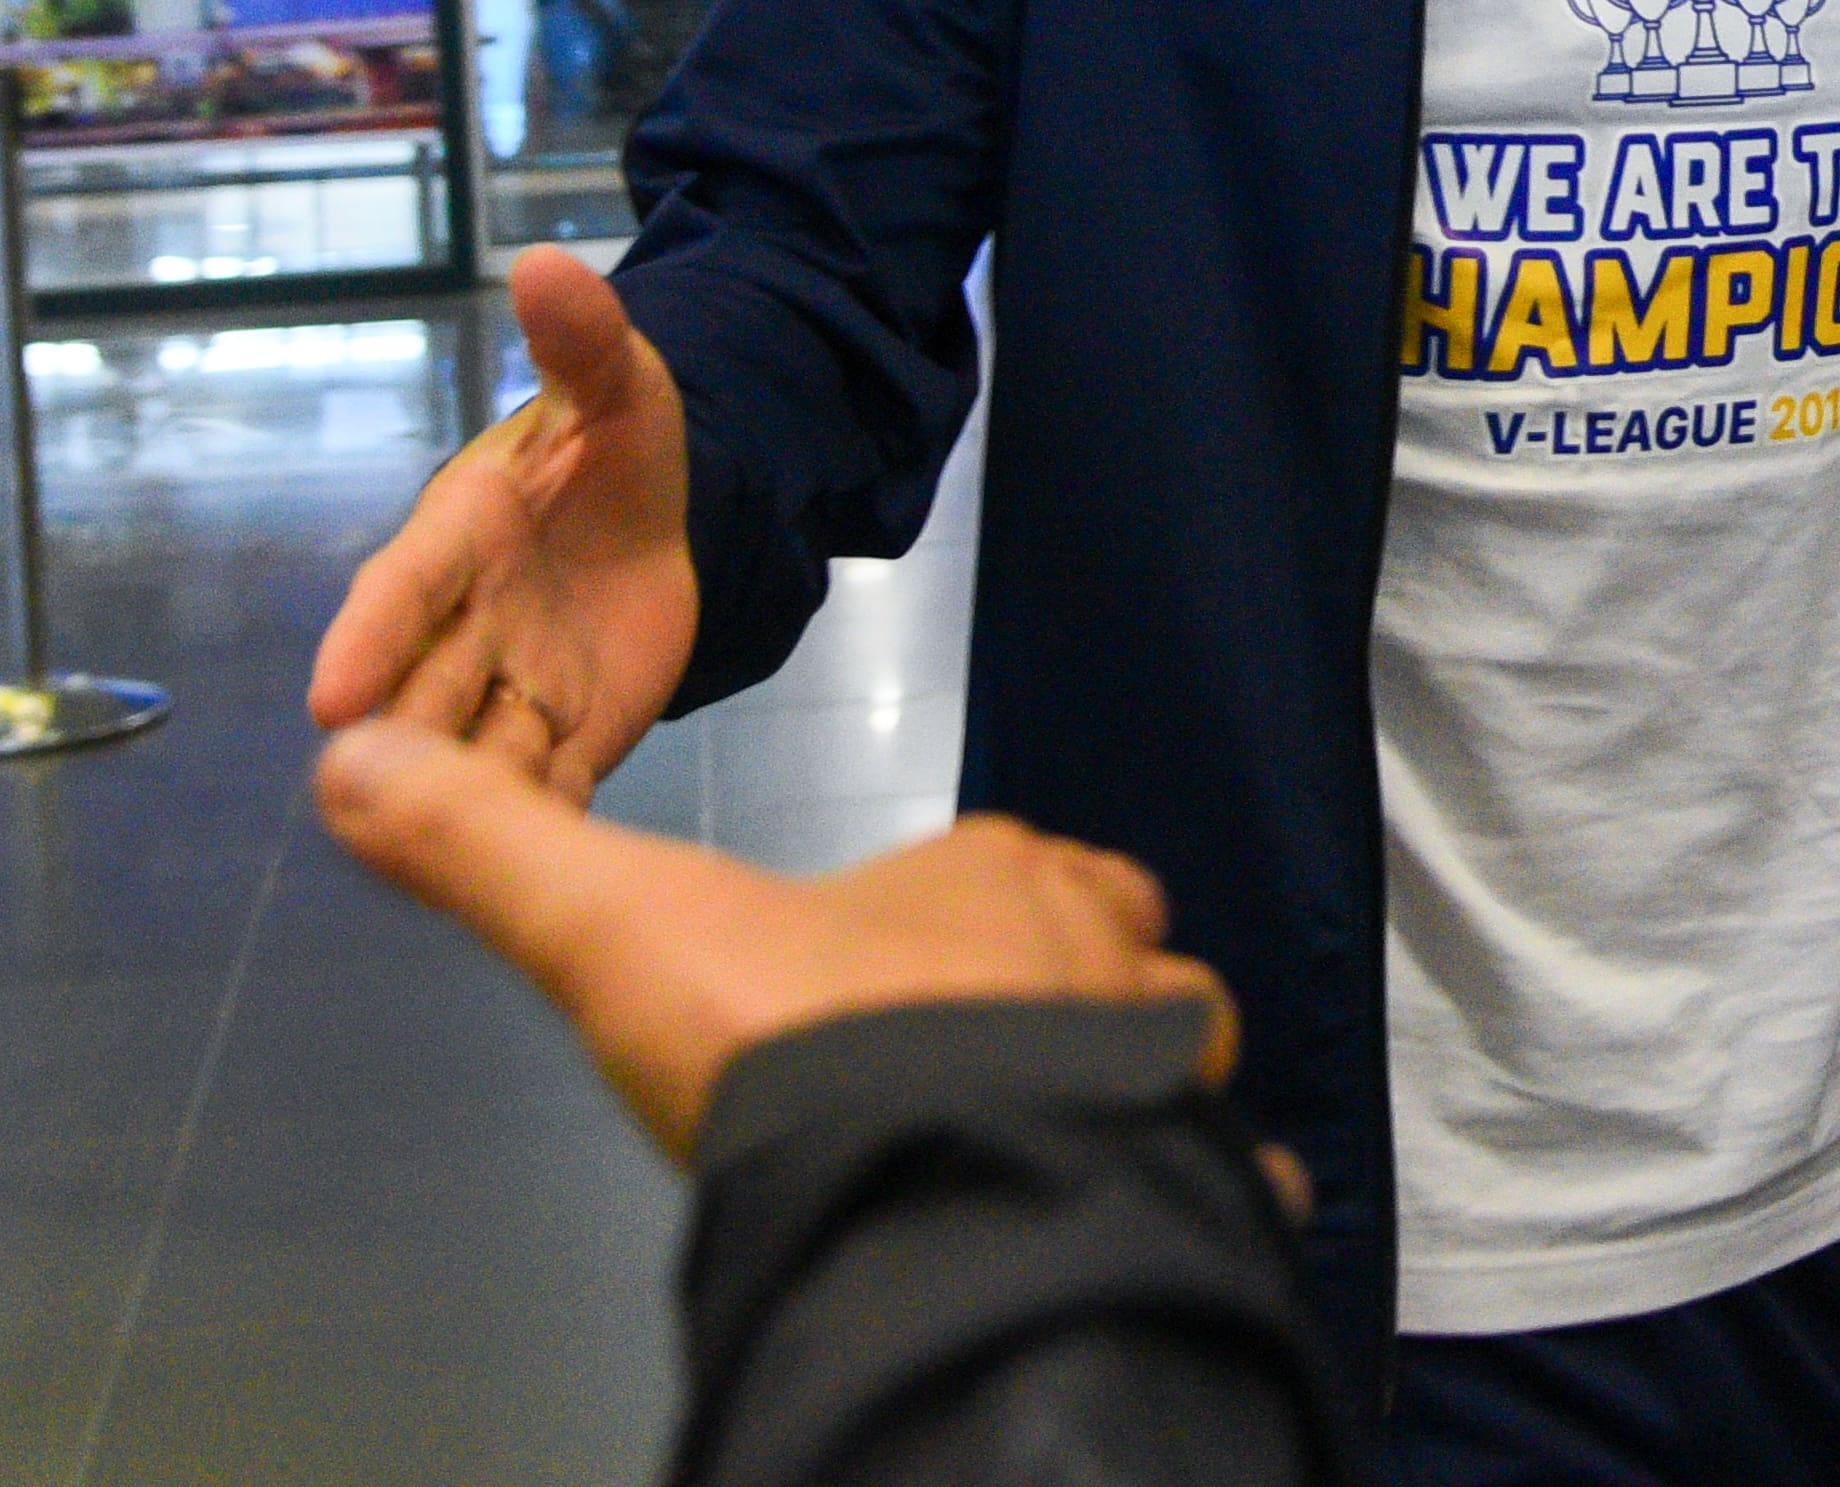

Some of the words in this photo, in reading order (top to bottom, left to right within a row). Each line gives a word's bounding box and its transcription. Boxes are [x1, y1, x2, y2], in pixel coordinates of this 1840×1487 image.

[1424, 132, 1585, 241] WE
[1601, 128, 1778, 242] ARE
[1485, 399, 1757, 455] V-LEAGUE
